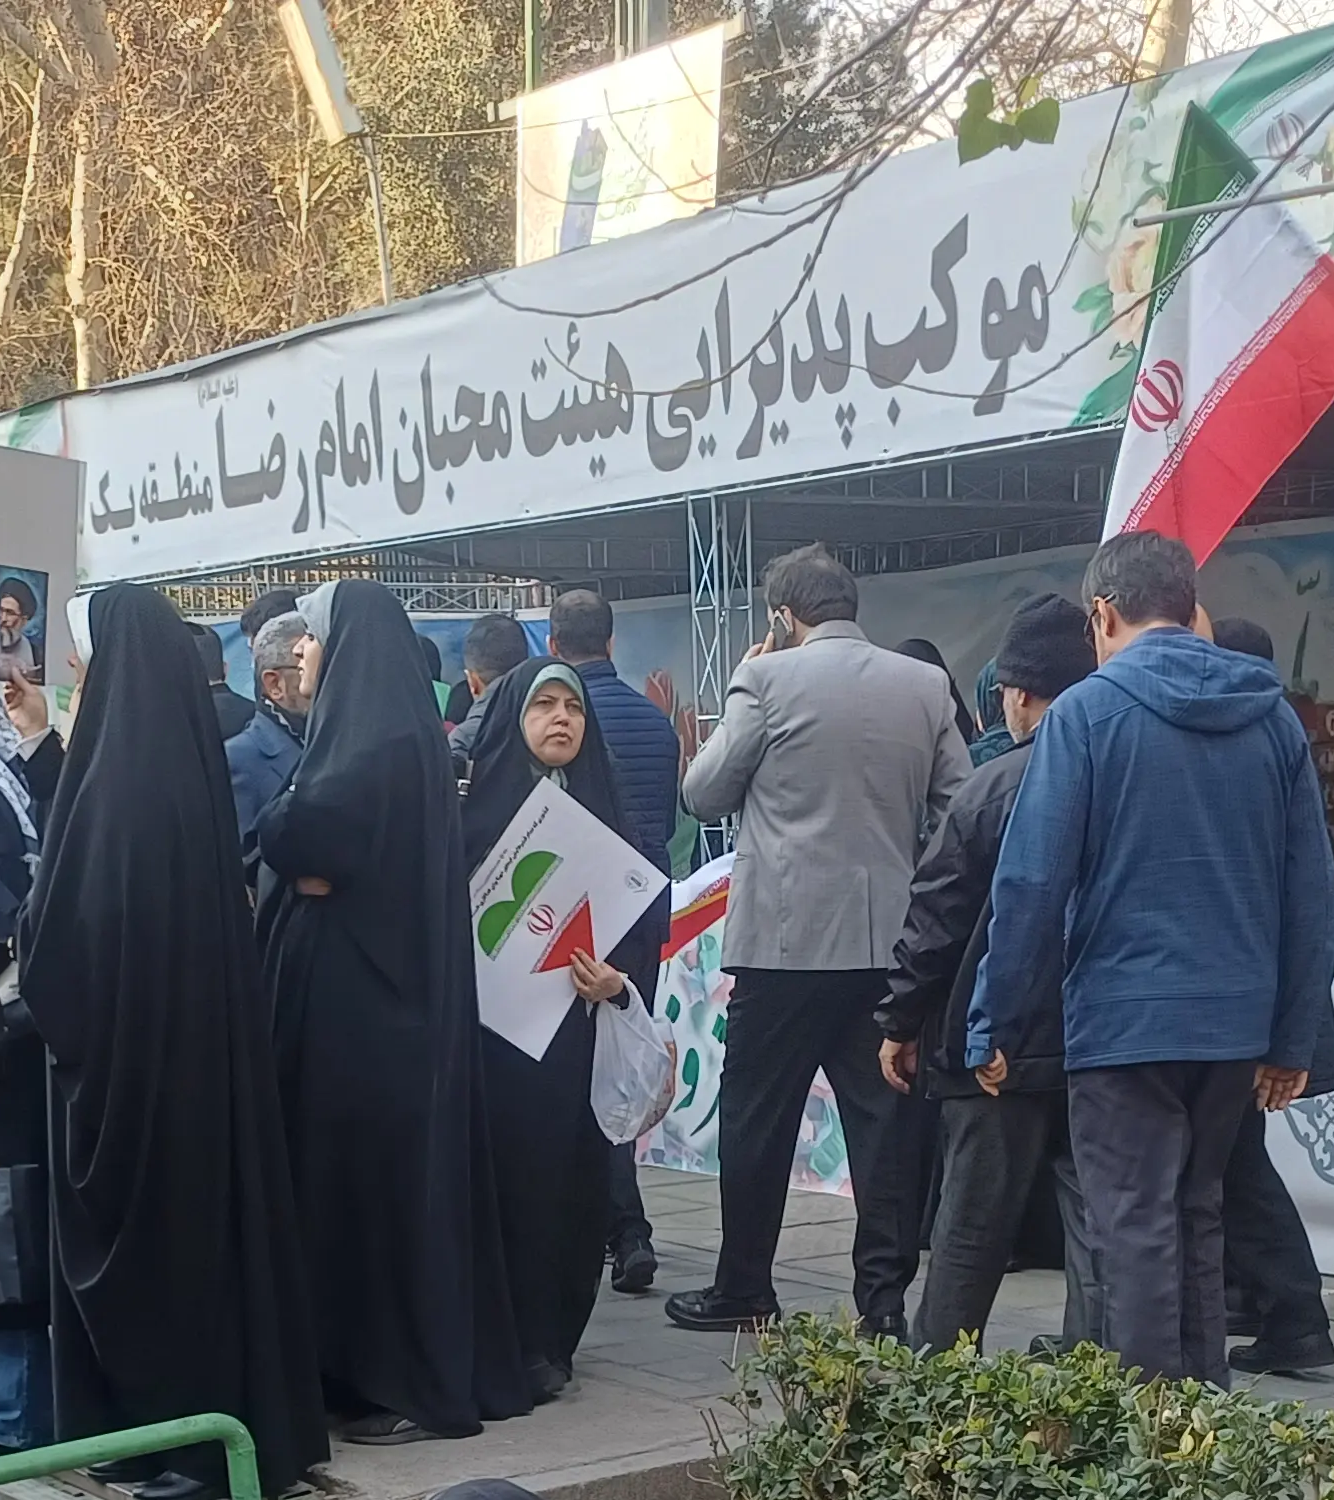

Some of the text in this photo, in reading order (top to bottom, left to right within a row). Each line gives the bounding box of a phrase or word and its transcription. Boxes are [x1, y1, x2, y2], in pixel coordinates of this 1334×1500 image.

[647, 252, 855, 472] پذیرایی
[865, 213, 1050, 427] موکب
[90, 470, 135, 545] یک
[139, 452, 213, 524] منطقه
[215, 398, 310, 534] رضا
[315, 367, 384, 530] امام
[393, 353, 512, 516] محبان
